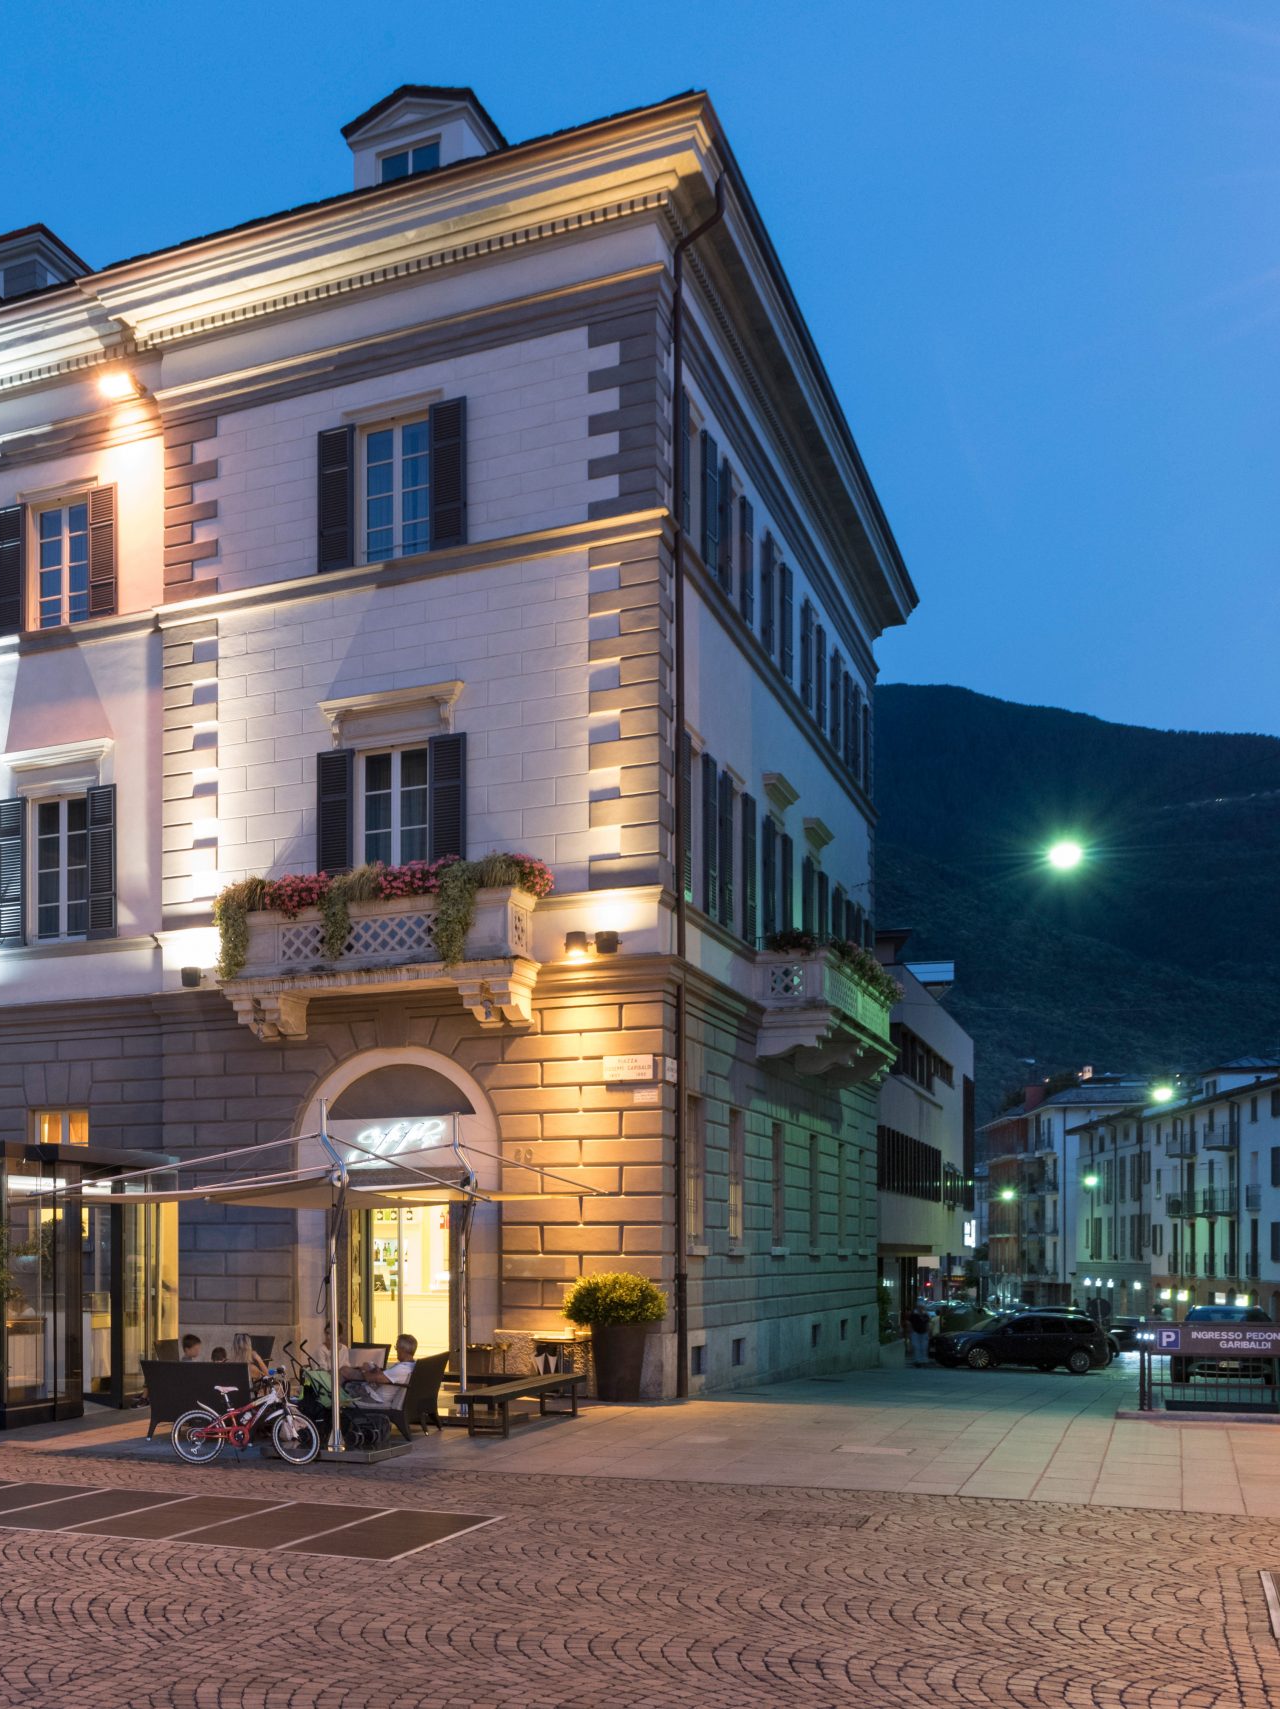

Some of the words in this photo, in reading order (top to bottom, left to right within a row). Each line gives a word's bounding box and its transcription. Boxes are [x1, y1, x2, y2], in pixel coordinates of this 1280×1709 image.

[1161, 1331, 1176, 1347] P
[1191, 1331, 1243, 1340] INGRESSO
[1219, 1340, 1272, 1350] GARIBALDI
